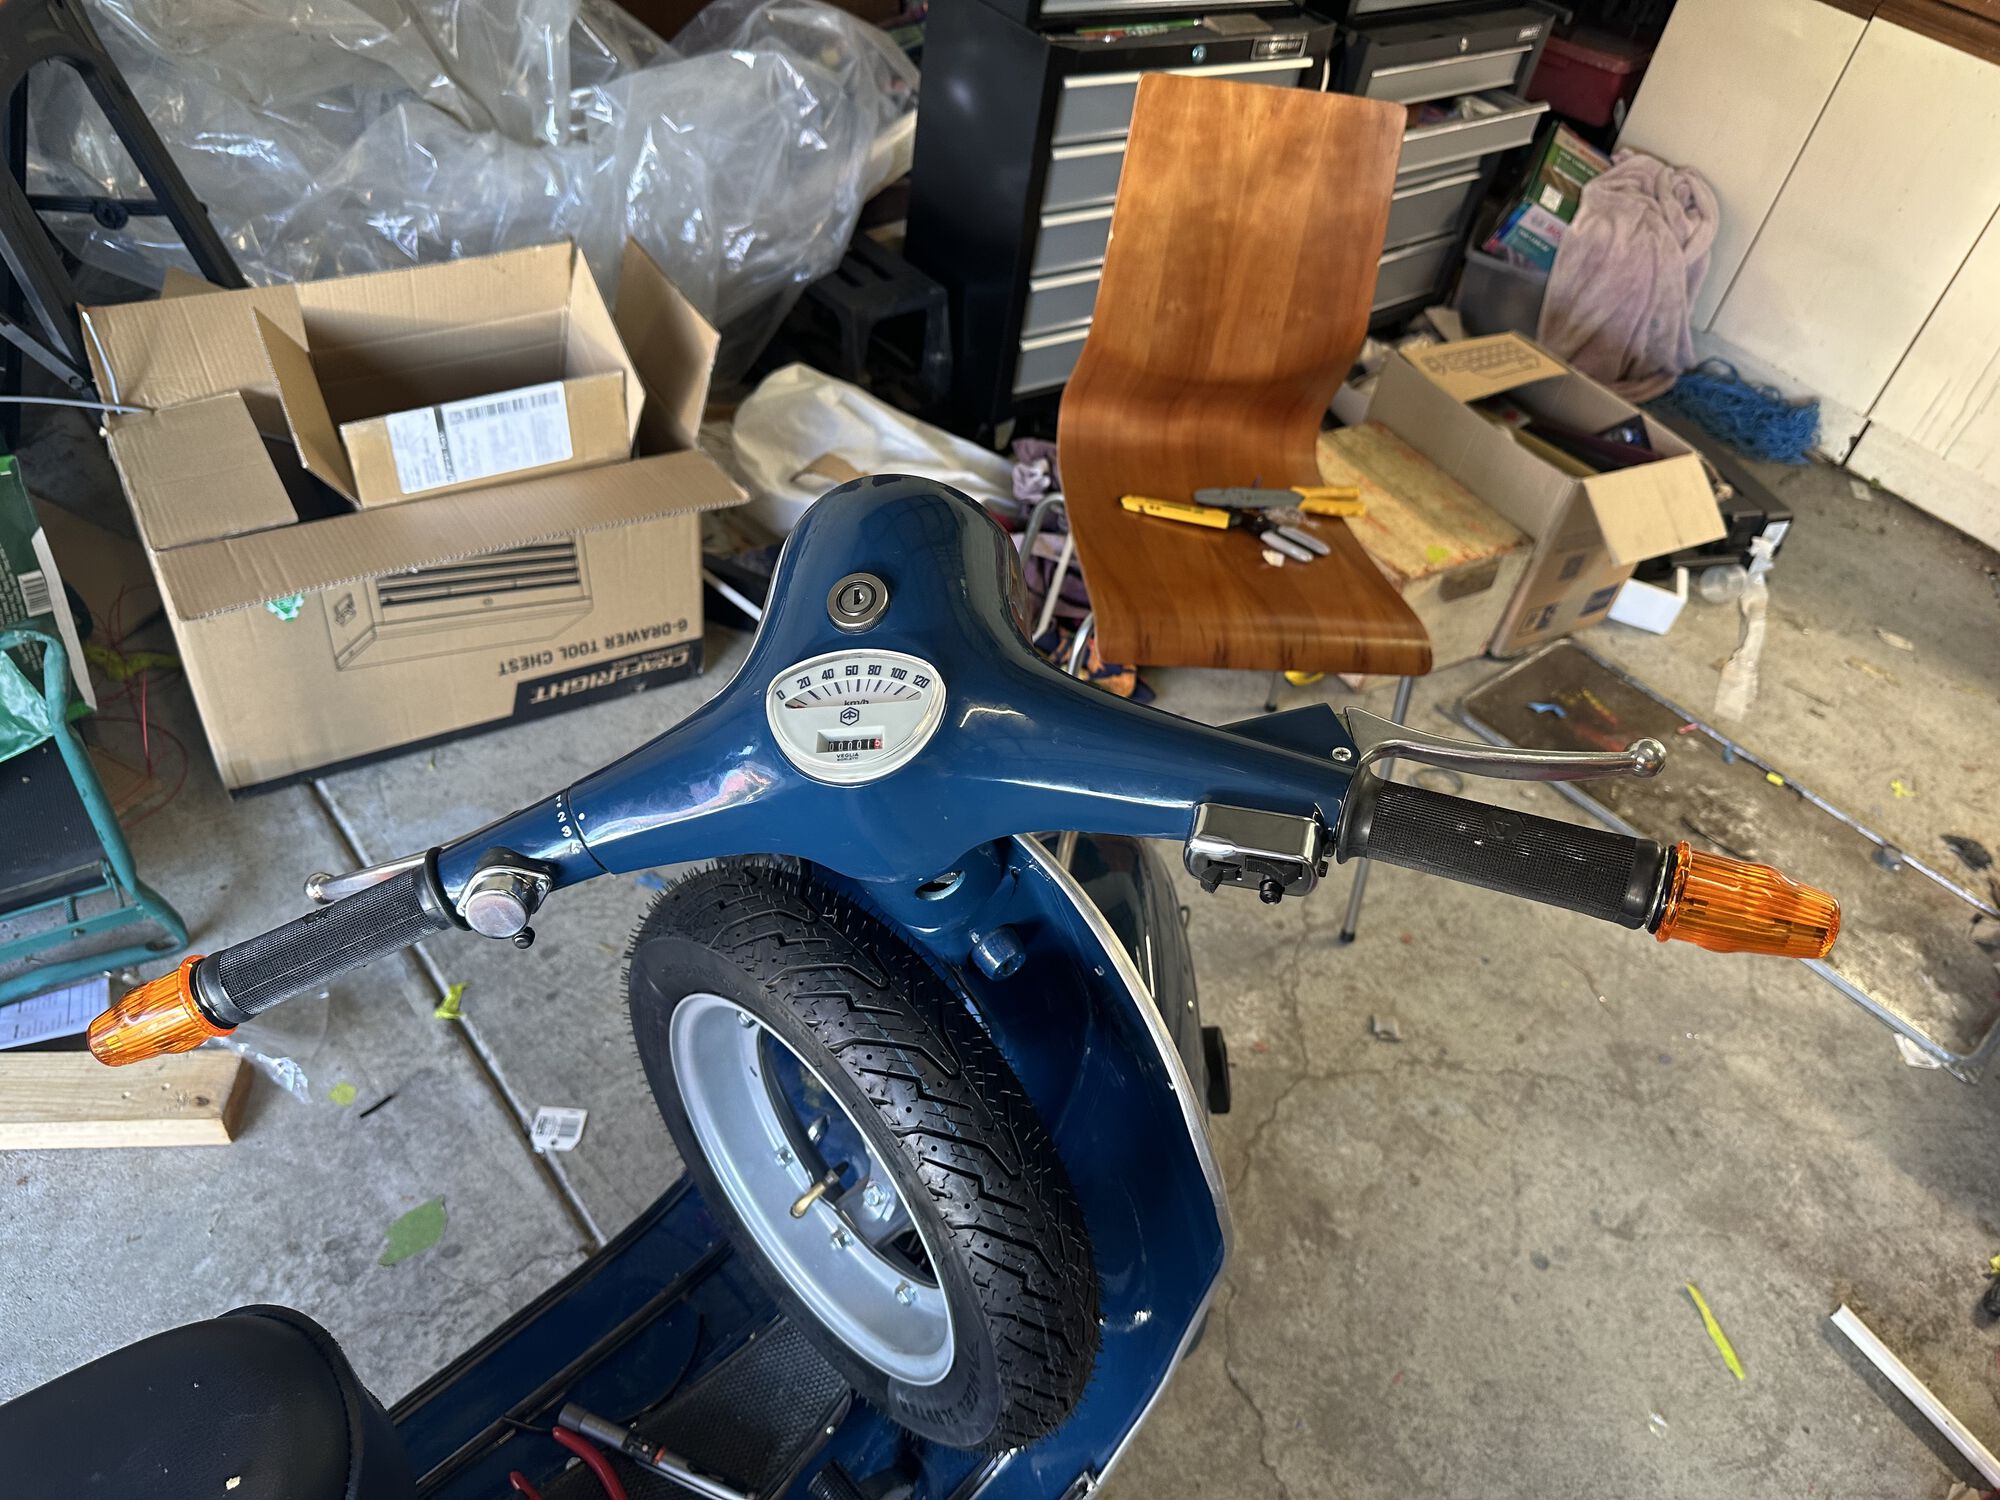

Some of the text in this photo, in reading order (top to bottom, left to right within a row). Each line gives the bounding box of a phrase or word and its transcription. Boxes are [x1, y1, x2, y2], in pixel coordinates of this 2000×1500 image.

[604, 618, 688, 649] 6-DRAWER
[558, 640, 599, 661] TOOL
[498, 651, 553, 676] CHEST
[776, 664, 931, 701] 0 20 40 60 80 100 120
[557, 811, 567, 823] 2
[561, 825, 573, 838] 3
